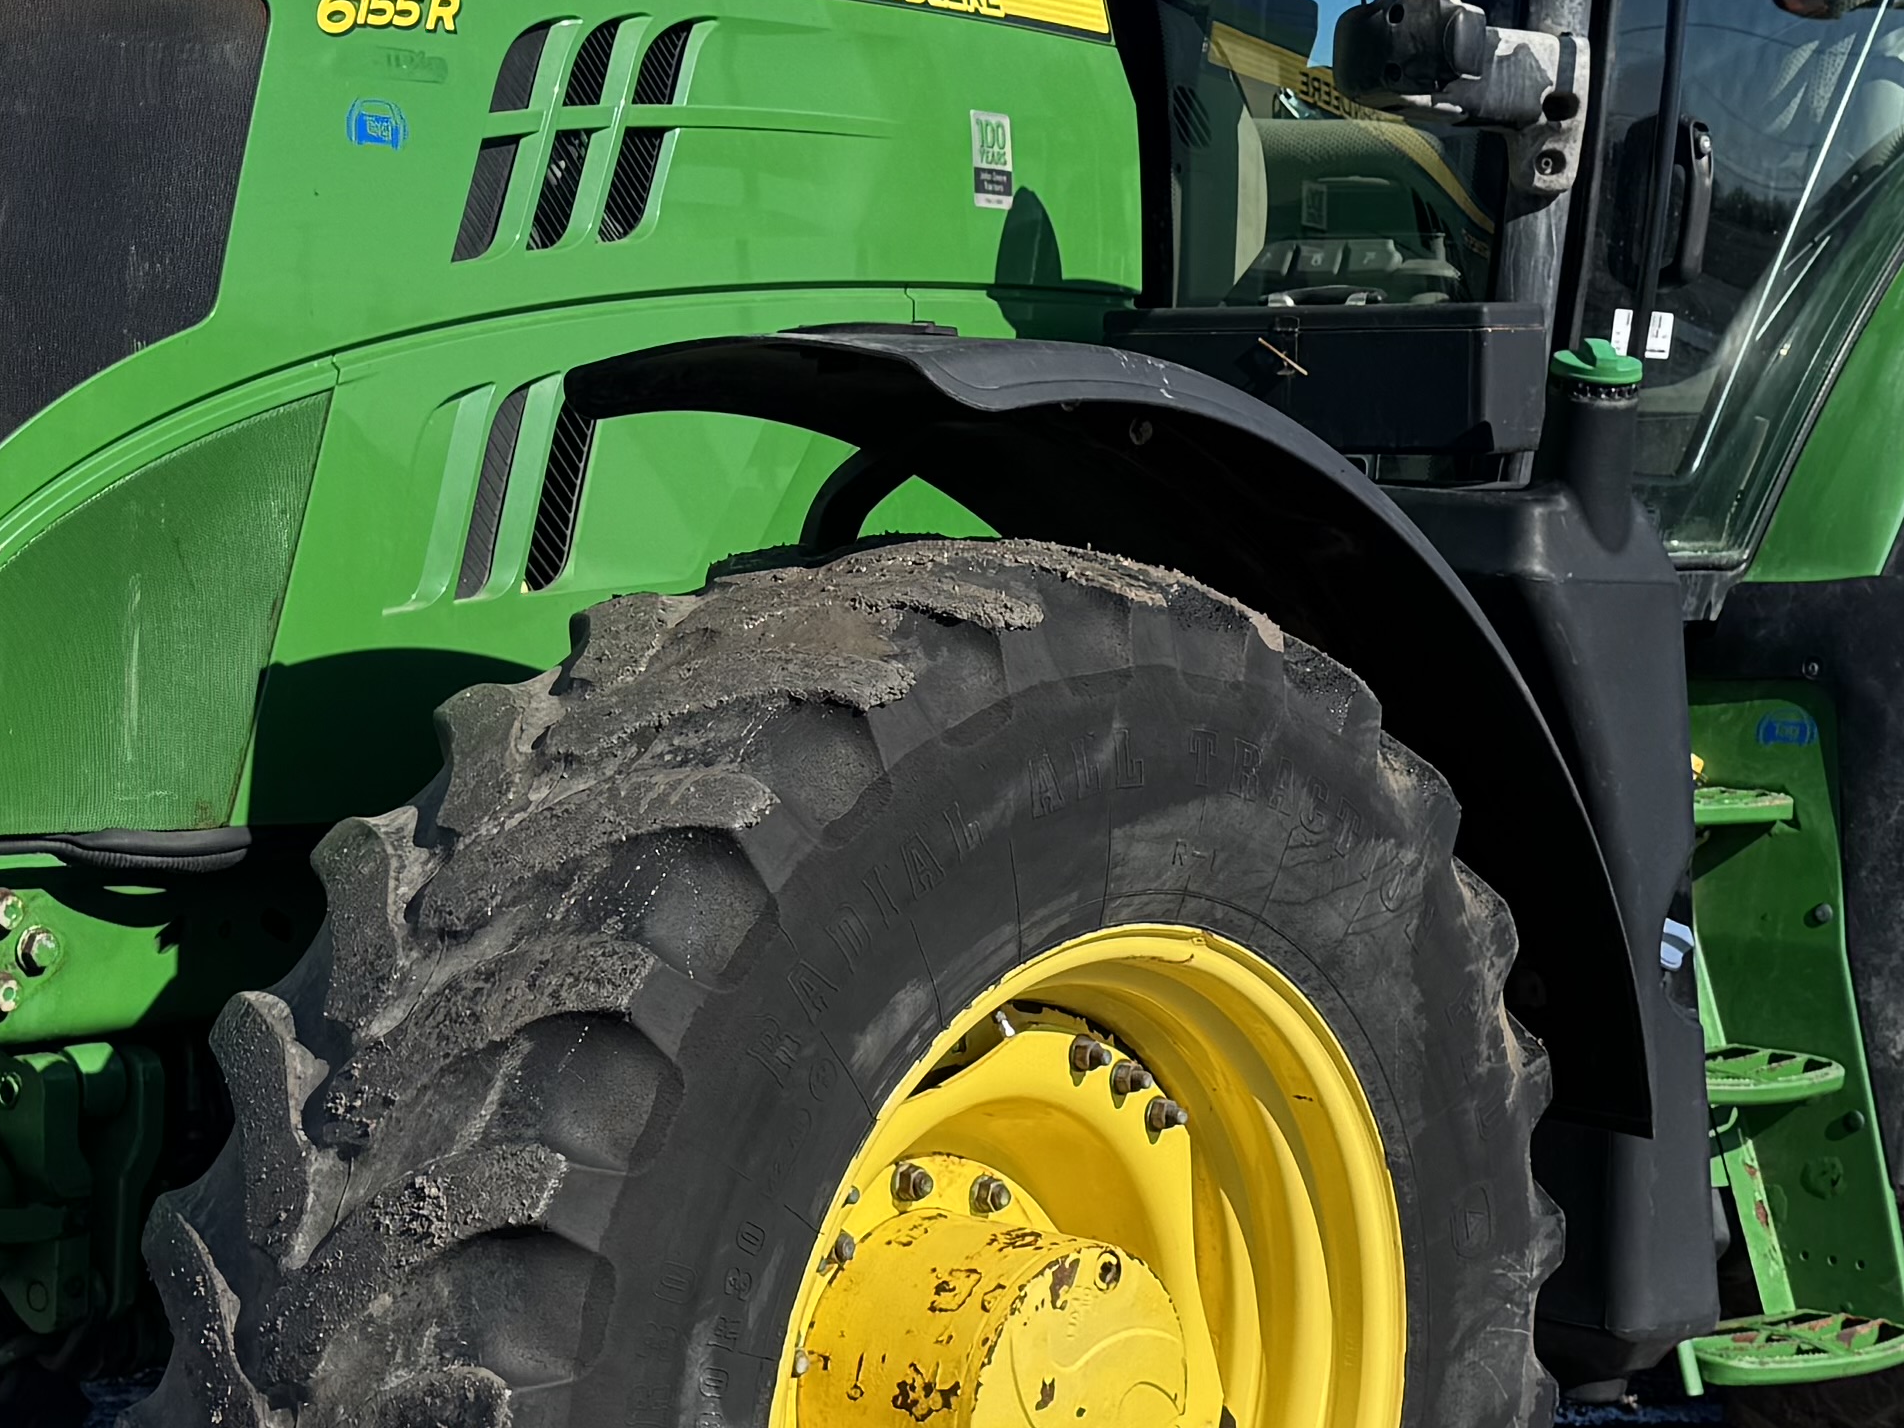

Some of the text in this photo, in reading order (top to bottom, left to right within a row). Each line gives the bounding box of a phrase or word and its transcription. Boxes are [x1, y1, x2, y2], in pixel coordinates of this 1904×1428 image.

[976, 119, 1006, 150] 100
[979, 149, 1007, 166] YEARS
[746, 800, 985, 1090] RADIAL
[1028, 726, 1146, 819] ALL
